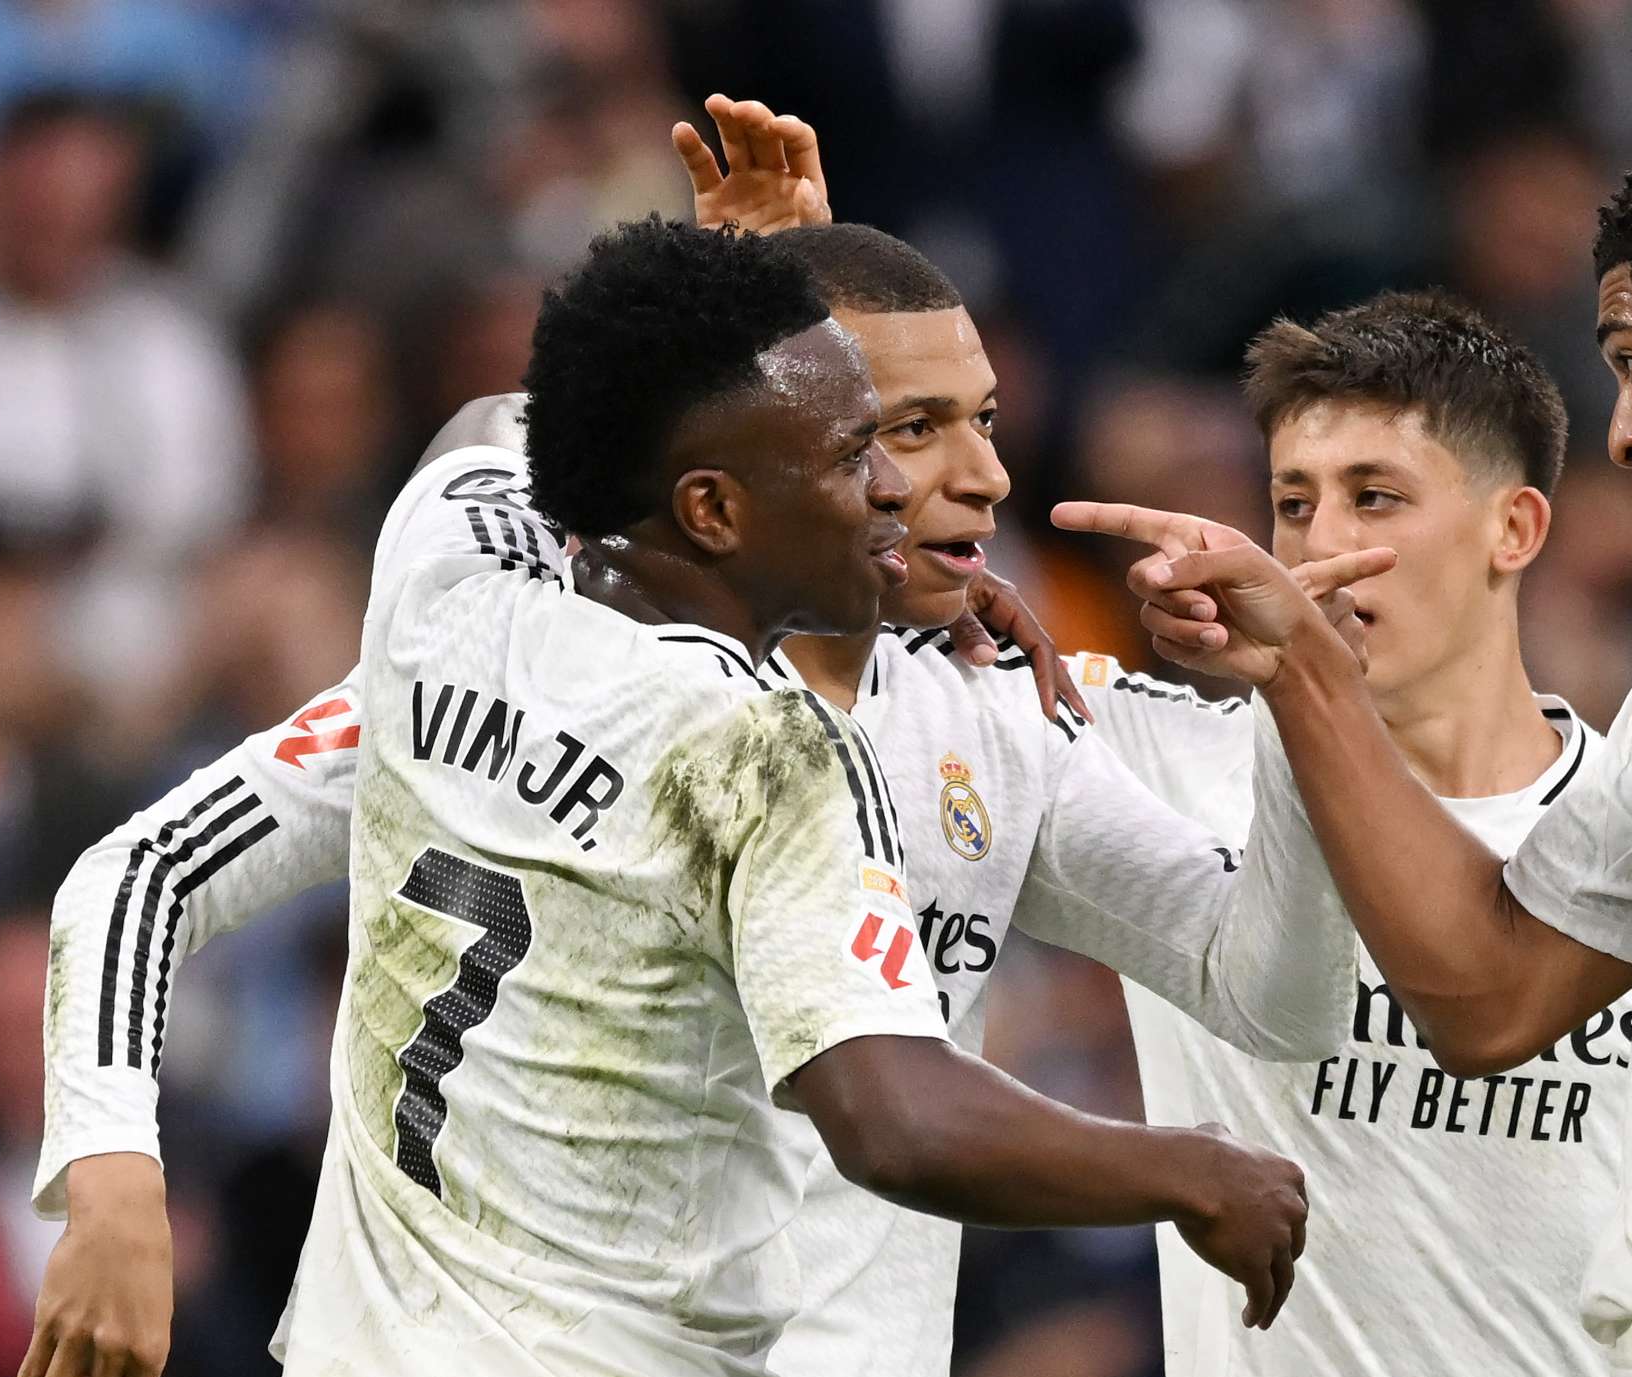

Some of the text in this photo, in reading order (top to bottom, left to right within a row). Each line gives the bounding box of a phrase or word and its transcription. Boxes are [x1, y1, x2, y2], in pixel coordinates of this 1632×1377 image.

[392, 846, 532, 1201] 7
[1311, 1056, 1592, 1143] FLY BETTER
